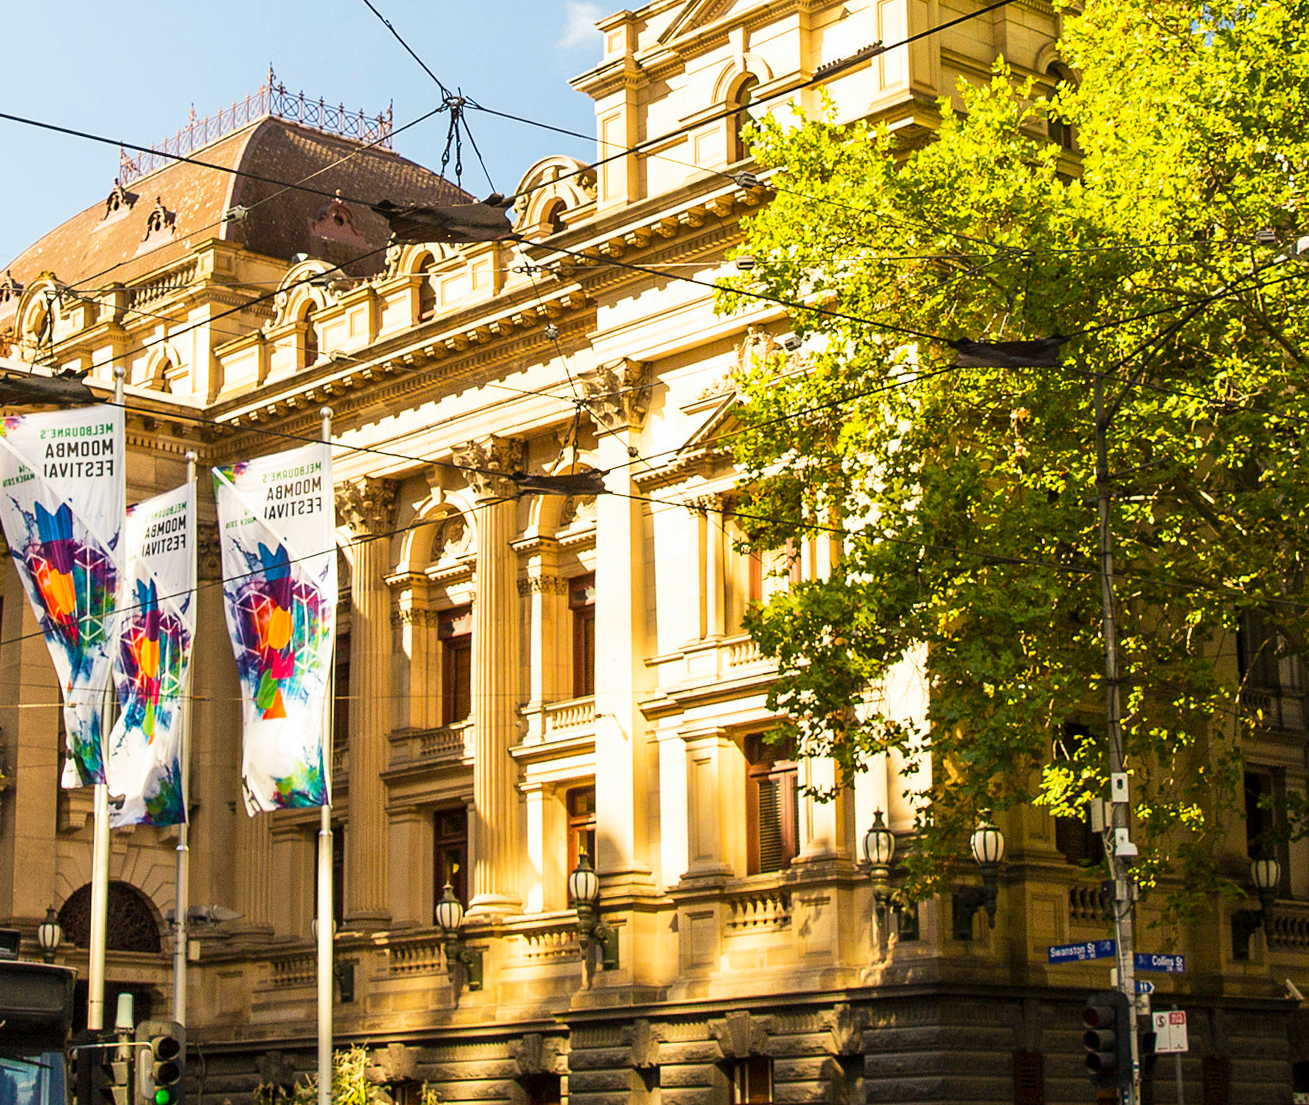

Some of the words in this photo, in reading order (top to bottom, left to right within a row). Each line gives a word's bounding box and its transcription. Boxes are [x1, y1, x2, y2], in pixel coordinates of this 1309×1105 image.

[1049, 946, 1086, 959] Swanston
[1086, 942, 1096, 955] St
[1152, 955, 1175, 967] Collins
[1175, 956, 1184, 967] St
